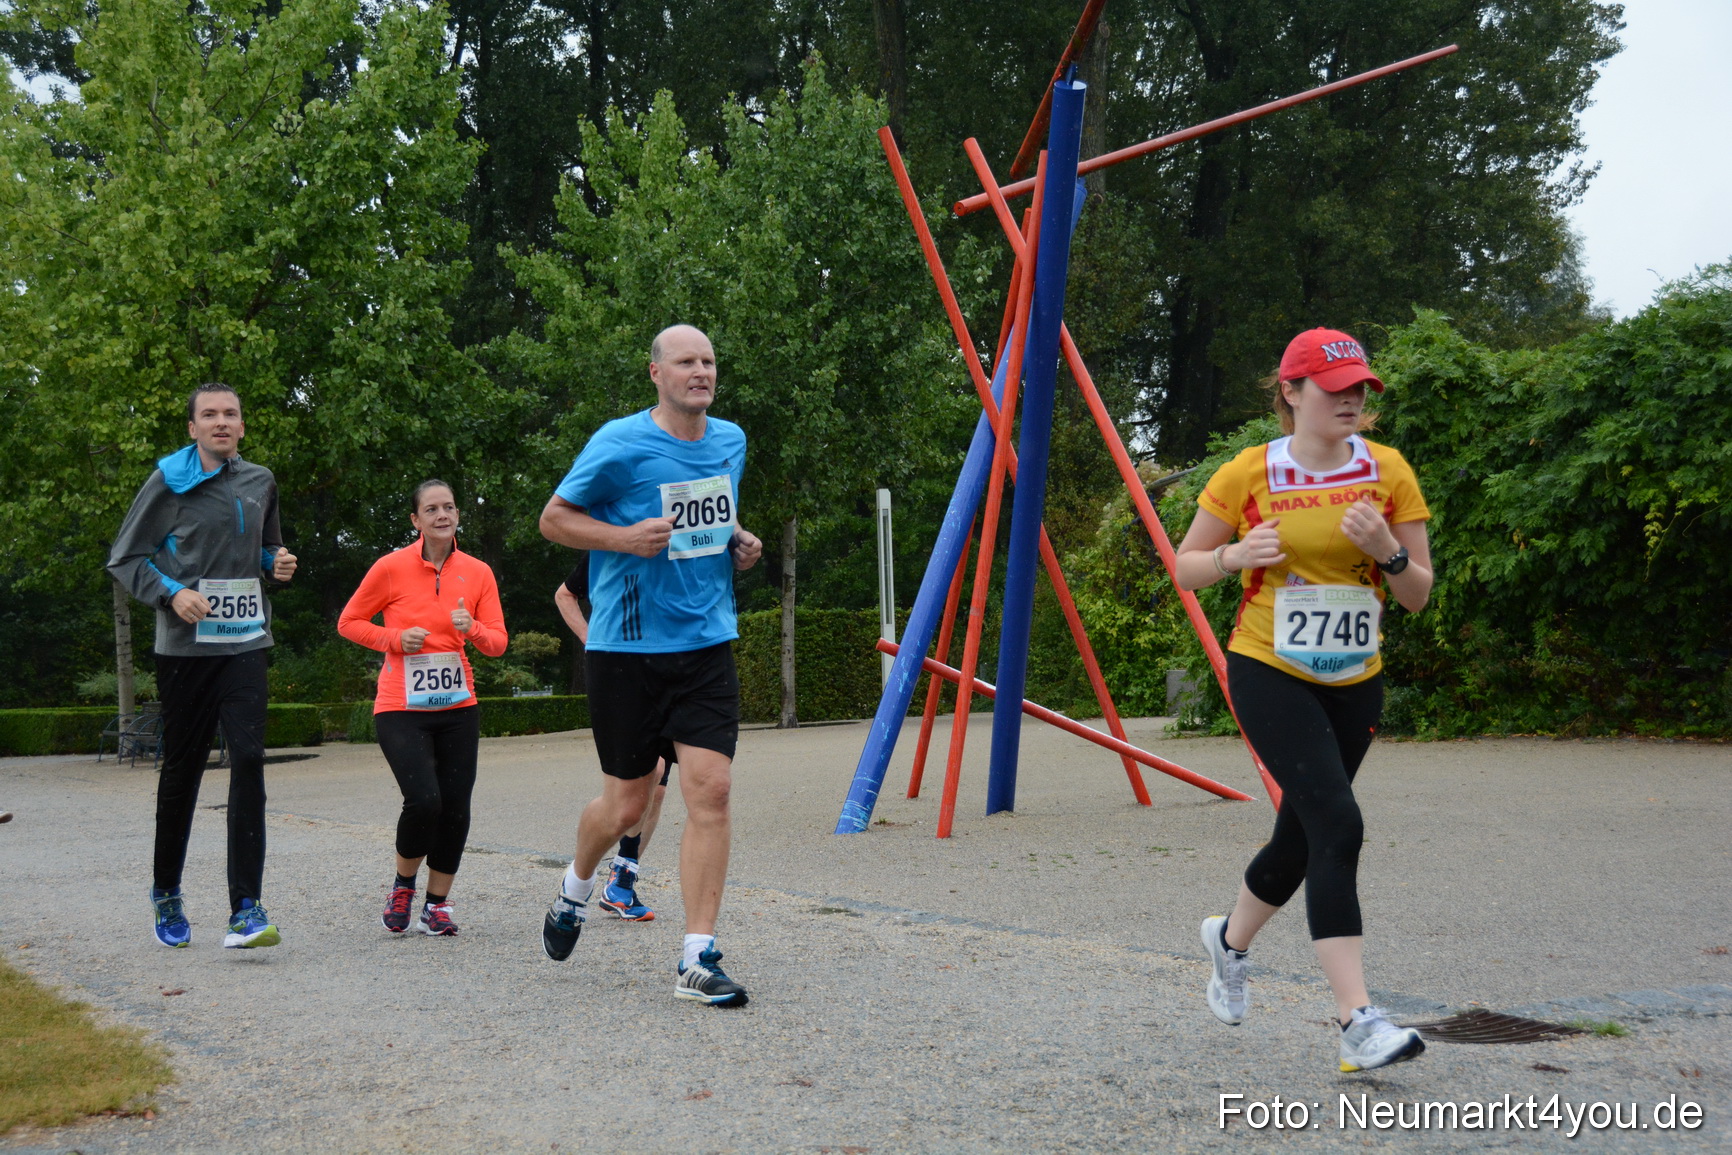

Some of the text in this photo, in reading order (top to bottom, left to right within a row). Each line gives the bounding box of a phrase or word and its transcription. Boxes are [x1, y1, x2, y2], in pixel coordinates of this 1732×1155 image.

[671, 494, 731, 530] 2069
[1270, 495, 1322, 513] MAX
[691, 532, 714, 547] Bubi
[206, 594, 258, 619] 2565
[217, 624, 250, 634] Manuel
[1287, 610, 1370, 647] 2746
[1312, 656, 1345, 673] Katja
[412, 667, 462, 692] 2564
[428, 695, 453, 705] Katrin
